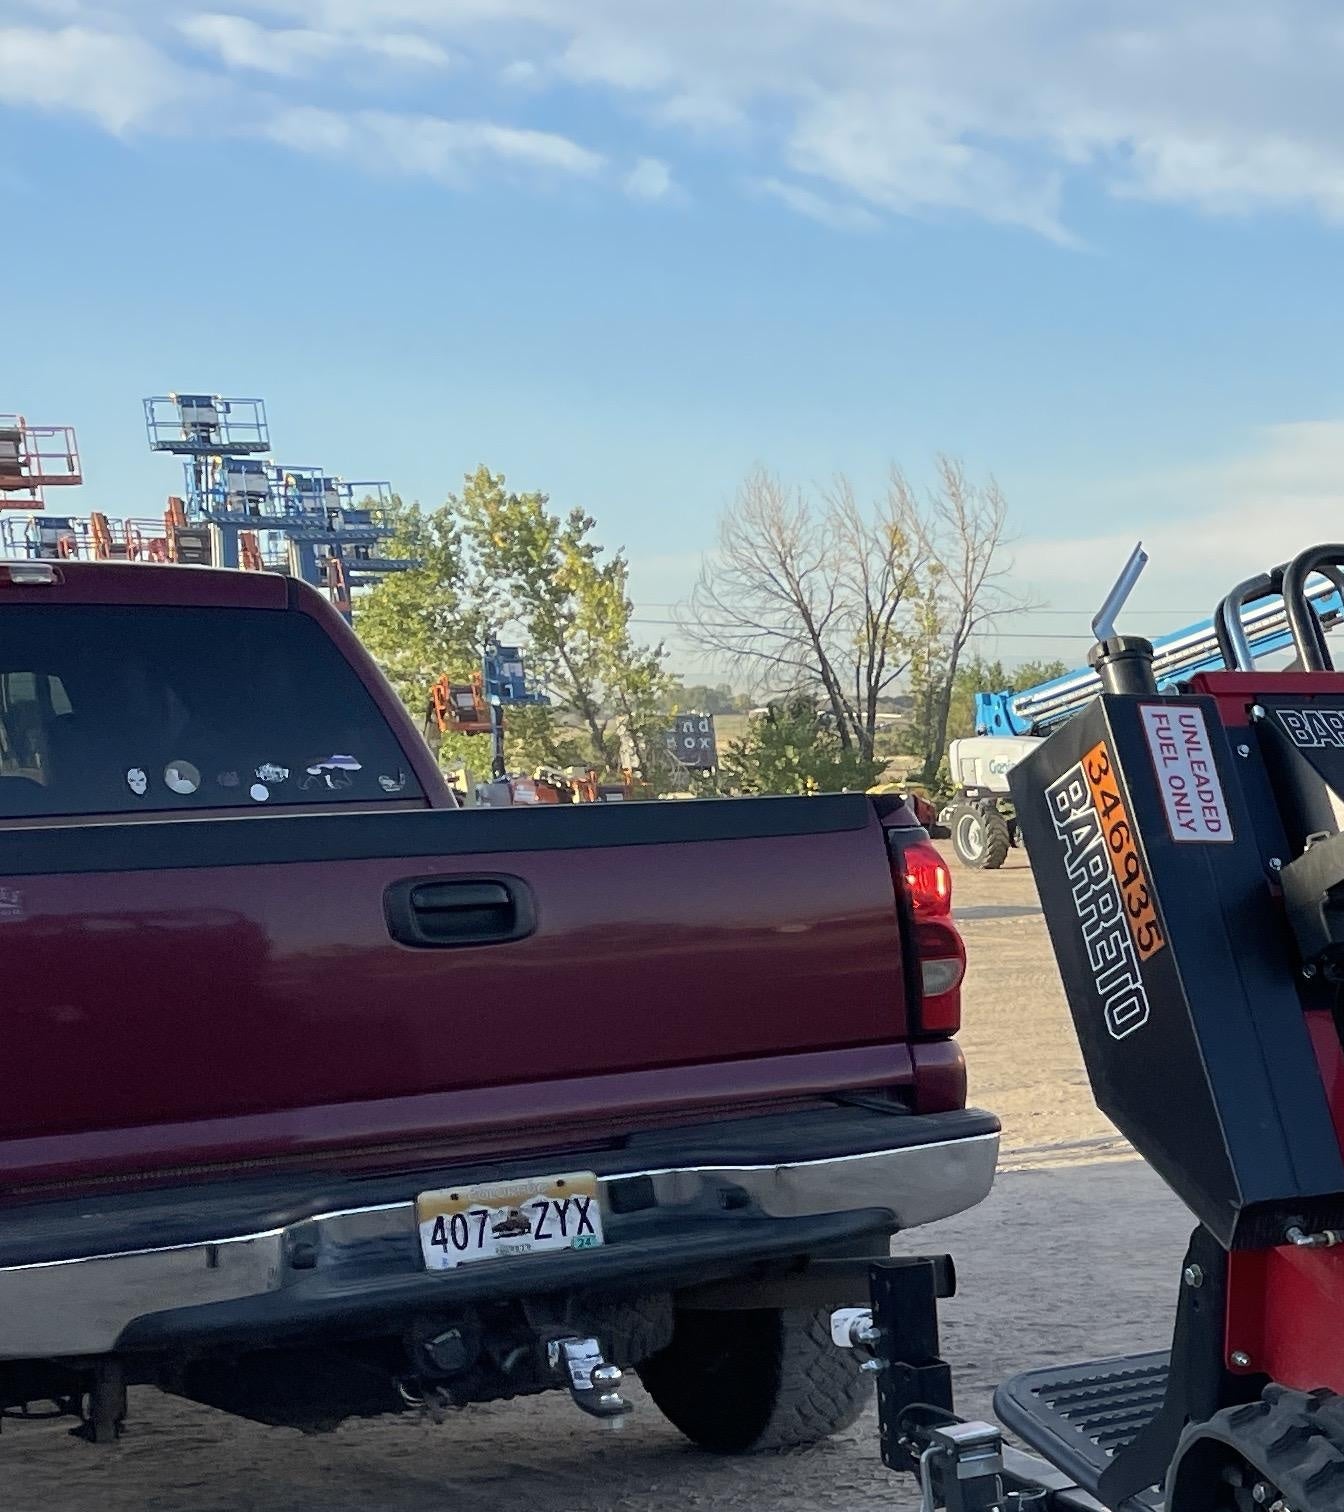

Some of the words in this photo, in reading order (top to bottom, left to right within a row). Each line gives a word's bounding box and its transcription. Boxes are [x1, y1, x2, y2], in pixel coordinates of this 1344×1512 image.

[1152, 713, 1177, 769] FUEL
[1167, 775, 1198, 834] ONLY
[1178, 714, 1222, 834] UNLEADED
[1045, 760, 1150, 1040] BARRETO
[1087, 751, 1163, 953] 346935
[431, 1209, 488, 1254] 407
[531, 1196, 595, 1241] ZYX
